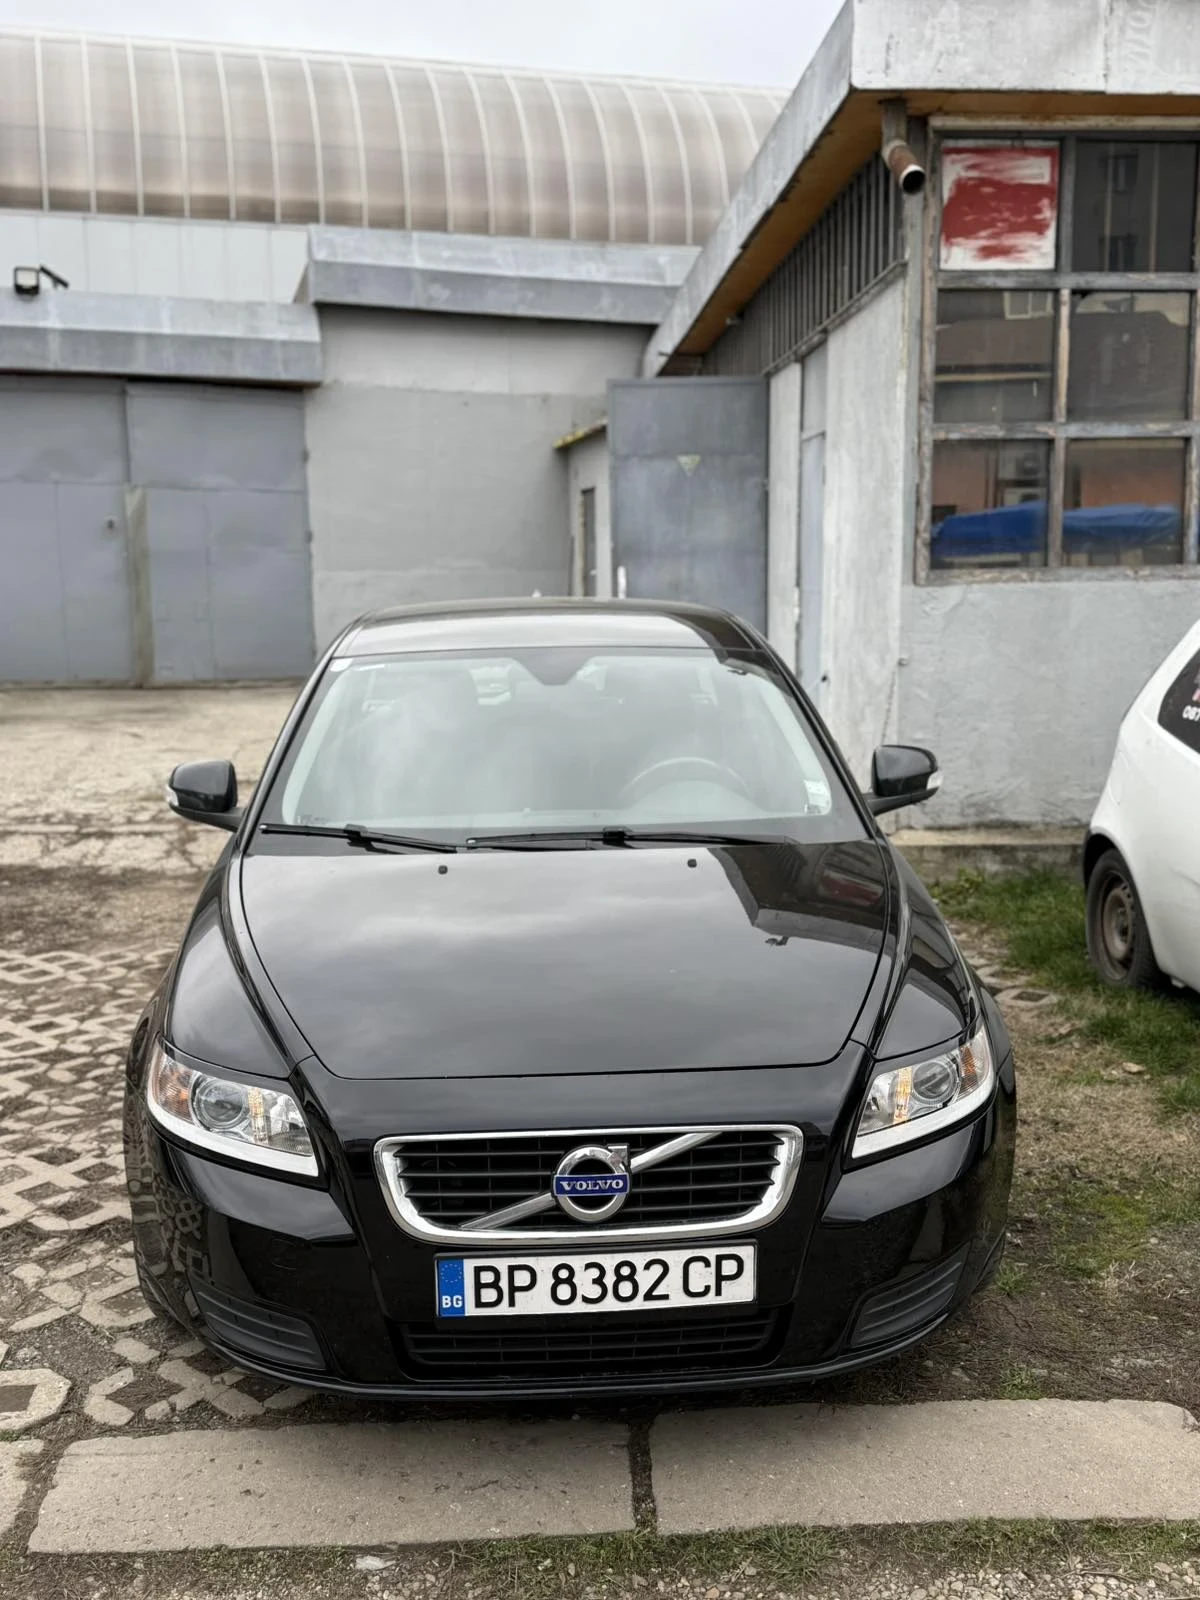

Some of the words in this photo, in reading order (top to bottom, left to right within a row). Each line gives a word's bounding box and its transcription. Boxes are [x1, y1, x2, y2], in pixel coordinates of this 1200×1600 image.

[560, 1179, 624, 1191] VOLVO
[473, 1264, 537, 1308] BP
[550, 1258, 669, 1306] 8382
[682, 1253, 744, 1298] CP
[442, 1295, 463, 1308] BG
